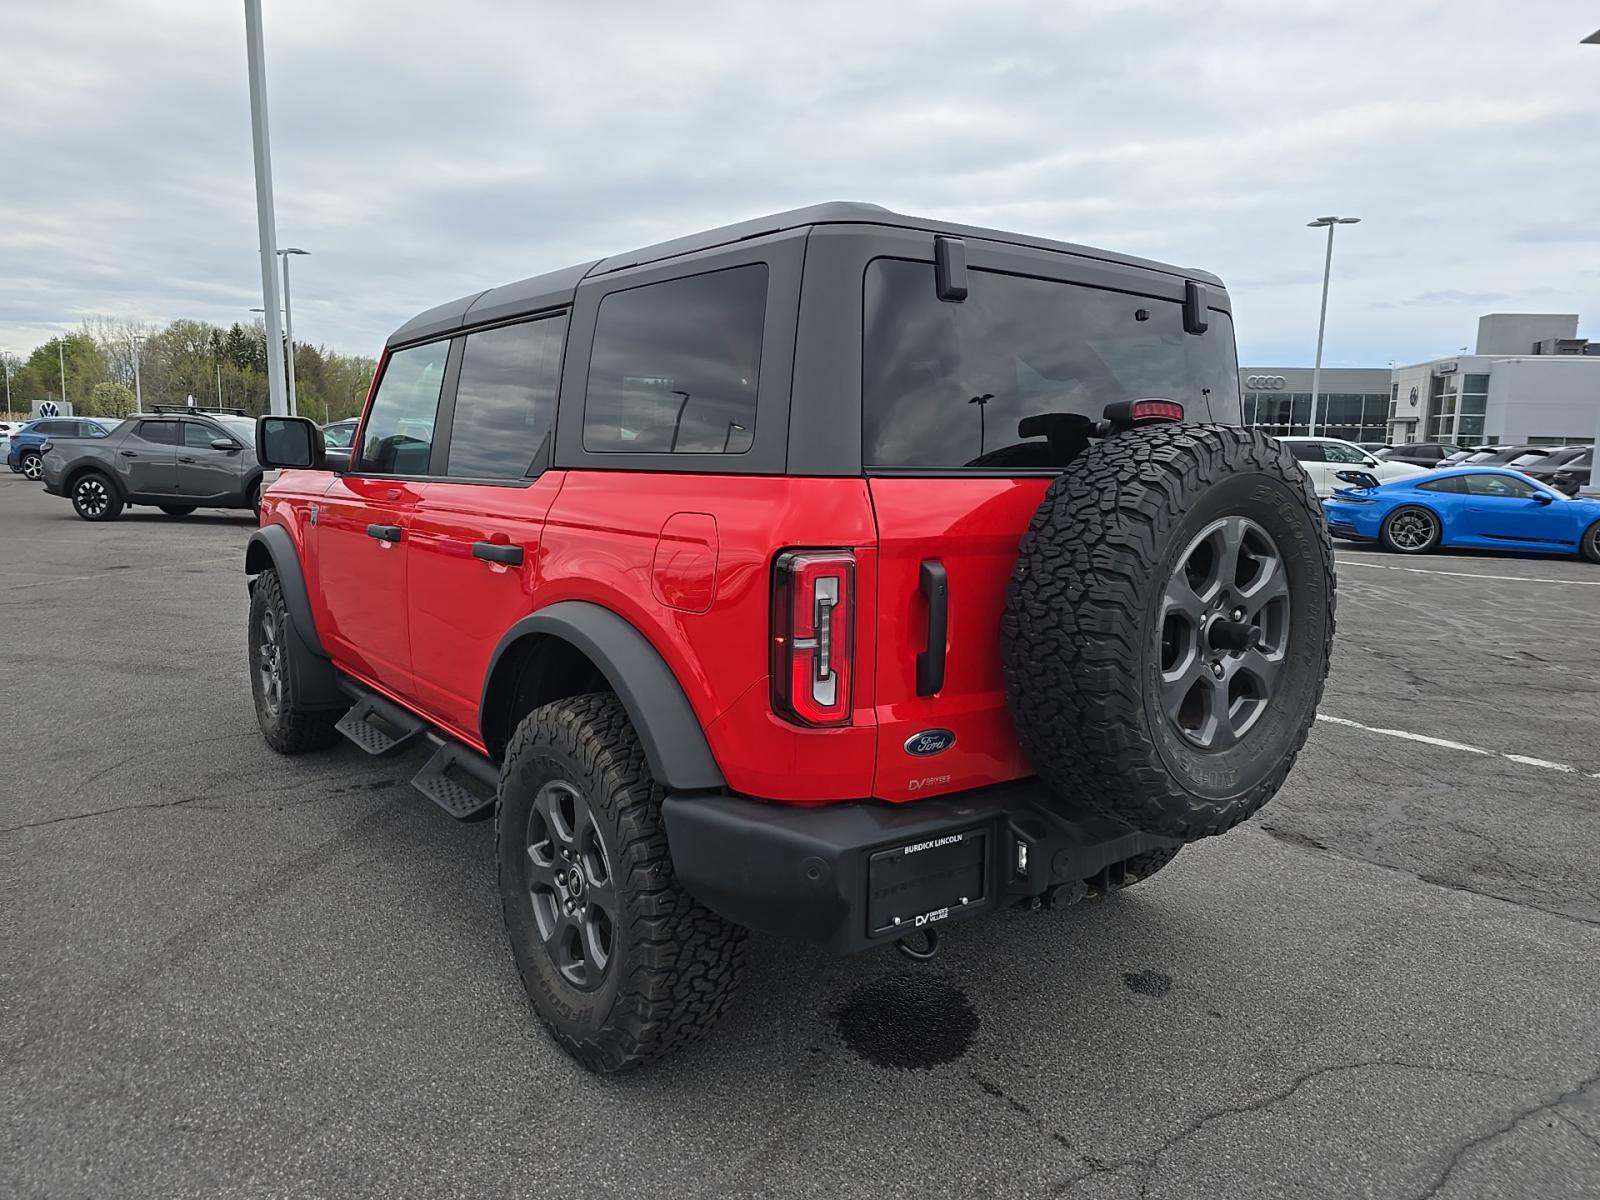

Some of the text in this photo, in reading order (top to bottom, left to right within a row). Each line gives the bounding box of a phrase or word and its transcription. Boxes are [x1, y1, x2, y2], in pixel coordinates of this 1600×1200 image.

[917, 736, 946, 752] Ford
[904, 834, 963, 855] BURDICK LINCOLN
[915, 913, 930, 927] DV
